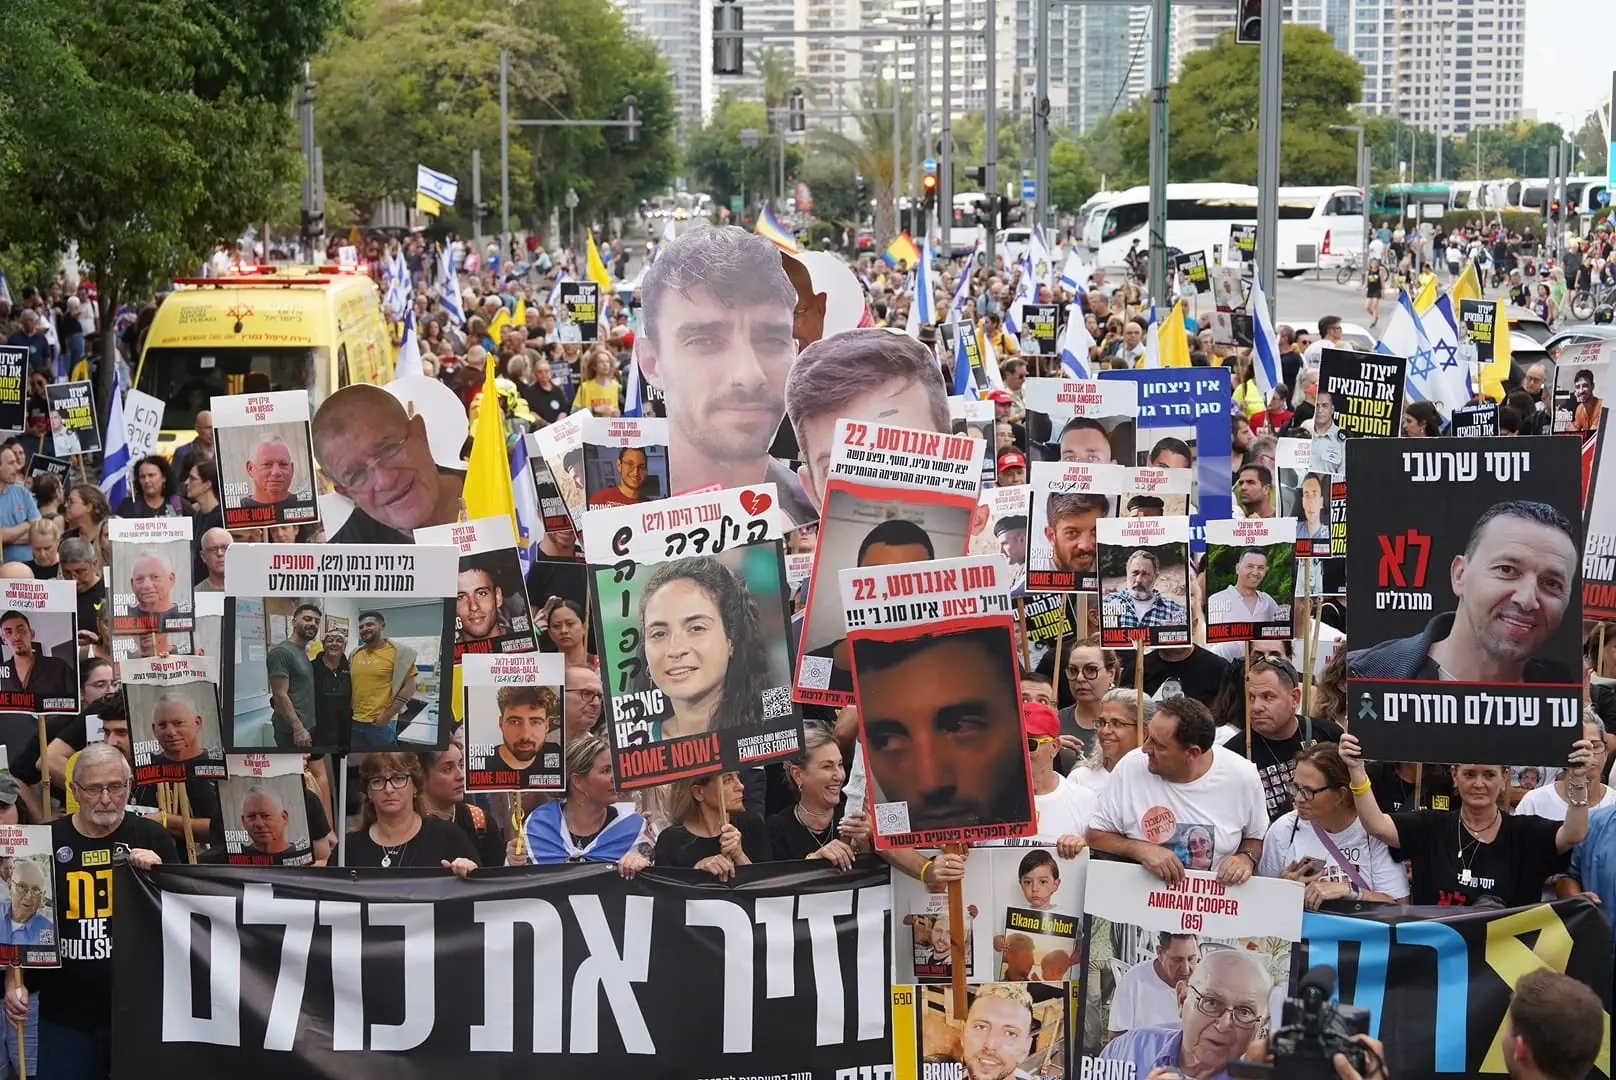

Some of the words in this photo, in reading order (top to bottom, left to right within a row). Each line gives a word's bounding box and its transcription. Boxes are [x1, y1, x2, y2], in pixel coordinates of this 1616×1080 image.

[1361, 362, 1397, 381] ״יצרנו
[1143, 382, 1190, 398] ניצחון
[1196, 380, 1220, 396] אין
[1328, 376, 1373, 398] התנאים
[1375, 381, 1395, 401] את
[1057, 394, 1075, 404] MATAN
[1077, 395, 1102, 404] ANGREST
[1346, 397, 1393, 418] לשחרור
[134, 404, 158, 428] הוא
[246, 405, 257, 414] ILAN
[258, 404, 274, 413] WEISS
[1159, 404, 1190, 415] הדר
[1195, 402, 1221, 418] סגן
[1333, 411, 1391, 436] החטופים״
[844, 422, 866, 446] 22
[869, 428, 940, 457] אנגרסט,
[847, 450, 866, 463] קשה
[943, 438, 974, 461] מתן
[867, 453, 885, 466] נפצע
[931, 456, 954, 473] לשמור
[1402, 451, 1478, 484] שרעבי
[1485, 451, 1531, 484] יוסי
[956, 463, 969, 475] יצא
[1063, 474, 1077, 482] DAVID
[884, 471, 915, 487] מהרשימה
[916, 475, 941, 488] המדינה
[954, 480, 976, 492] והוצא
[225, 483, 248, 496] BRING
[226, 497, 241, 509] HIM
[226, 509, 250, 523] HOME
[251, 506, 276, 521] NOW!
[668, 507, 694, 529] הימן
[697, 503, 722, 524] ענבר
[641, 512, 666, 534] (27)
[1141, 528, 1165, 536] MARGALIT
[665, 515, 769, 558] הילדה
[1232, 529, 1246, 537] YOSSI
[1247, 529, 1268, 537] SHARABI
[1031, 547, 1054, 559] BRING
[1587, 535, 1616, 557] BRI
[269, 554, 314, 571] חטופים.
[346, 555, 371, 573] ברמן
[375, 554, 393, 572] וזיו
[398, 554, 415, 571] גלי
[1376, 528, 1432, 588] לא
[962, 565, 996, 589] מתן
[1583, 557, 1615, 581] HIM
[268, 573, 319, 592] המוחלט
[322, 574, 371, 594] הניצחון
[374, 574, 415, 592] תמונת
[882, 573, 957, 602] אנגרסט,
[1029, 573, 1051, 584] HOME
[1052, 572, 1075, 585] NOW!
[852, 577, 876, 601] 22
[1583, 584, 1616, 608] HOM
[114, 593, 136, 605] BRING
[942, 597, 978, 617] פצוע
[981, 594, 1009, 612] חייל
[1376, 590, 1433, 611] מתרגלים
[886, 604, 911, 620] סוג
[913, 600, 939, 618] אינו
[1102, 604, 1127, 616] BRING
[1102, 616, 1118, 628] HIM
[1209, 625, 1230, 636] HOME
[1231, 623, 1253, 635] NOW!
[1103, 628, 1124, 640] HOME
[1127, 627, 1150, 640] NOW!
[112, 638, 134, 650] BRING
[491, 666, 501, 674] GUY
[502, 666, 540, 674] GILBOA-DALAL
[612, 689, 664, 721] BRNG
[1383, 692, 1458, 724] חוזרים
[1464, 692, 1540, 727] שכולם
[1546, 697, 1578, 728] עד
[738, 734, 763, 747] HOSTAGES
[764, 732, 774, 743] AND
[775, 728, 798, 740] MISSING
[133, 740, 160, 755] BRING
[469, 744, 495, 757] BRING
[619, 746, 668, 778] HOME
[671, 732, 722, 768] NOW!
[738, 744, 772, 761] FAMILIES
[772, 737, 799, 753] FORUM
[135, 754, 152, 767] HIM
[469, 756, 486, 770] HIM
[136, 766, 160, 780] HOME
[163, 763, 187, 778] NOW!
[469, 771, 494, 785] HOME
[495, 770, 520, 785] NOW!
[1433, 796, 1449, 810] 690
[1144, 811, 1171, 828] הושבה
[1146, 819, 1175, 838] לקבורה
[225, 831, 249, 843] BRING
[925, 829, 961, 842] פצועים
[966, 826, 1006, 839] מפקירים
[226, 842, 242, 854] HIM
[83, 850, 110, 866] 690
[1480, 878, 1495, 890] יוסי
[1147, 891, 1193, 911] AMIRAM
[1196, 896, 1239, 916] COOPER
[78, 919, 107, 940] THE
[1011, 912, 1039, 931] Elkana
[1041, 915, 1073, 935] Dohbot
[1181, 913, 1203, 932] (85)
[60, 938, 113, 960] BULLSH
[160, 882, 435, 1053] כולם
[470, 893, 656, 1055] את
[893, 992, 912, 1006] 690
[923, 1062, 963, 1080] BRING
[1079, 1055, 1137, 1080] BRING
